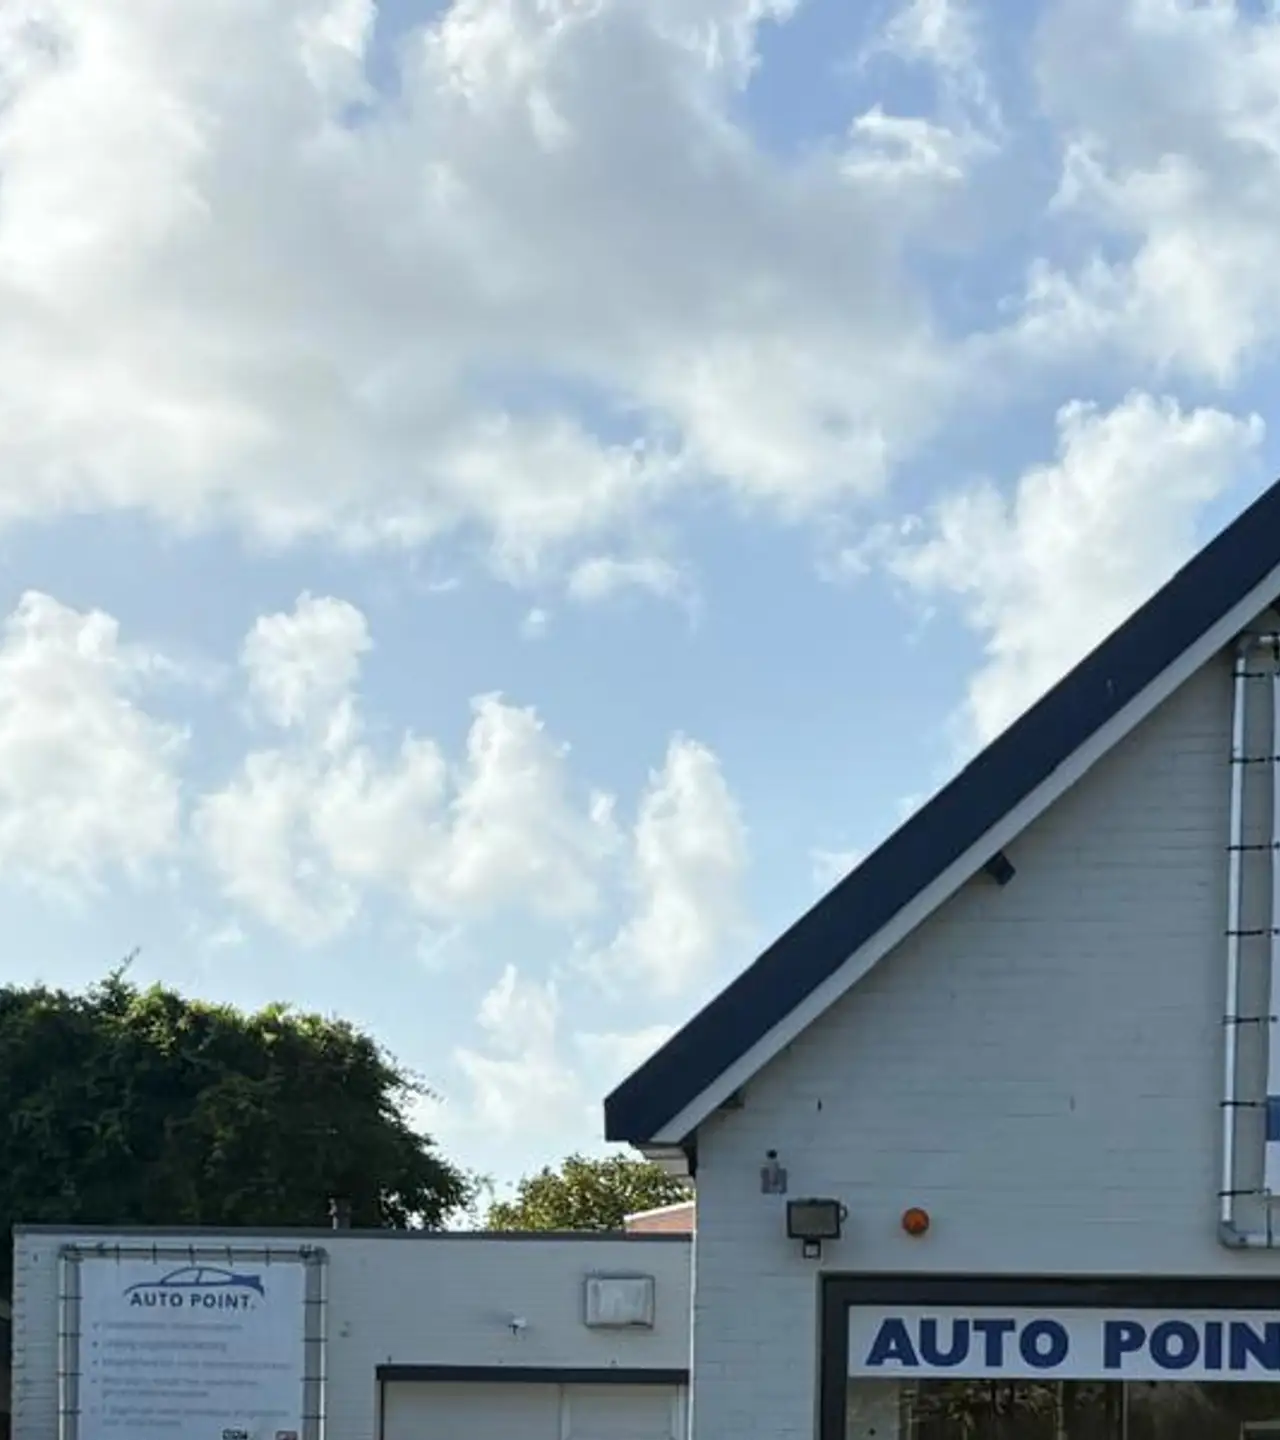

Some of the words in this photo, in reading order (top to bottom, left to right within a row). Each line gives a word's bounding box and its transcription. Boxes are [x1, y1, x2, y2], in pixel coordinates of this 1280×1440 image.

[129, 1292, 183, 1308] AUTO
[189, 1292, 257, 1310] POINT.
[864, 1315, 1071, 1371] AUTO
